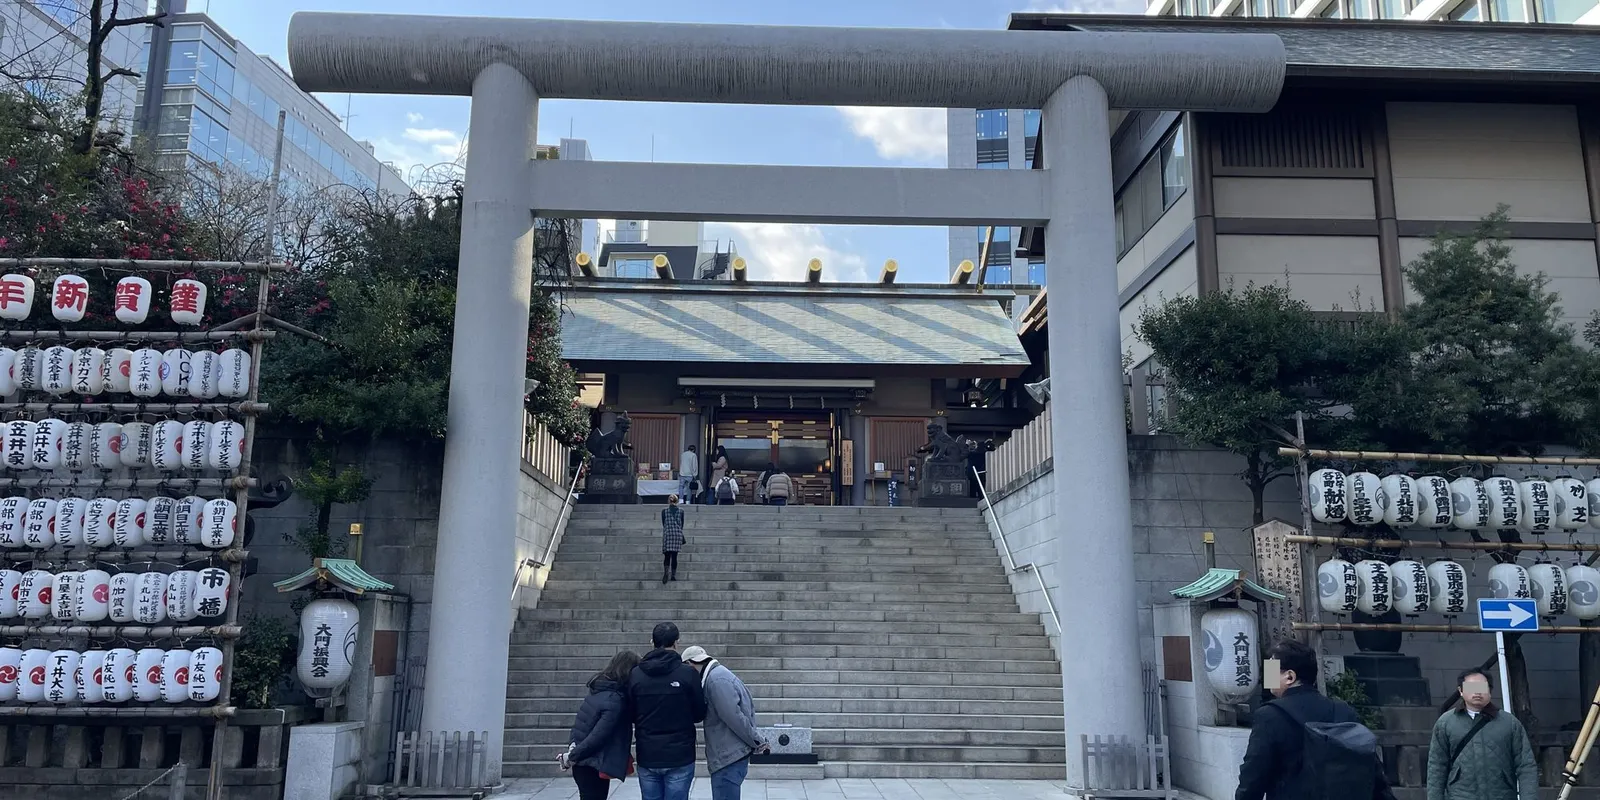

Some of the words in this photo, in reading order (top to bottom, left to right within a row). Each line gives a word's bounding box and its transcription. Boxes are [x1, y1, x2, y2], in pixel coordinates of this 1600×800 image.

[55, 280, 88, 312] 新
[115, 283, 142, 312] 賀
[171, 283, 200, 314] 謹
[8, 422, 27, 465] 笠井家
[34, 421, 52, 463] 笠井家
[27, 501, 47, 543] 加部和弘
[1570, 484, 1587, 523] 竹芝
[198, 569, 225, 617] 市橋
[311, 624, 332, 677] 大門振興会
[1234, 632, 1252, 686] 大門振興会
